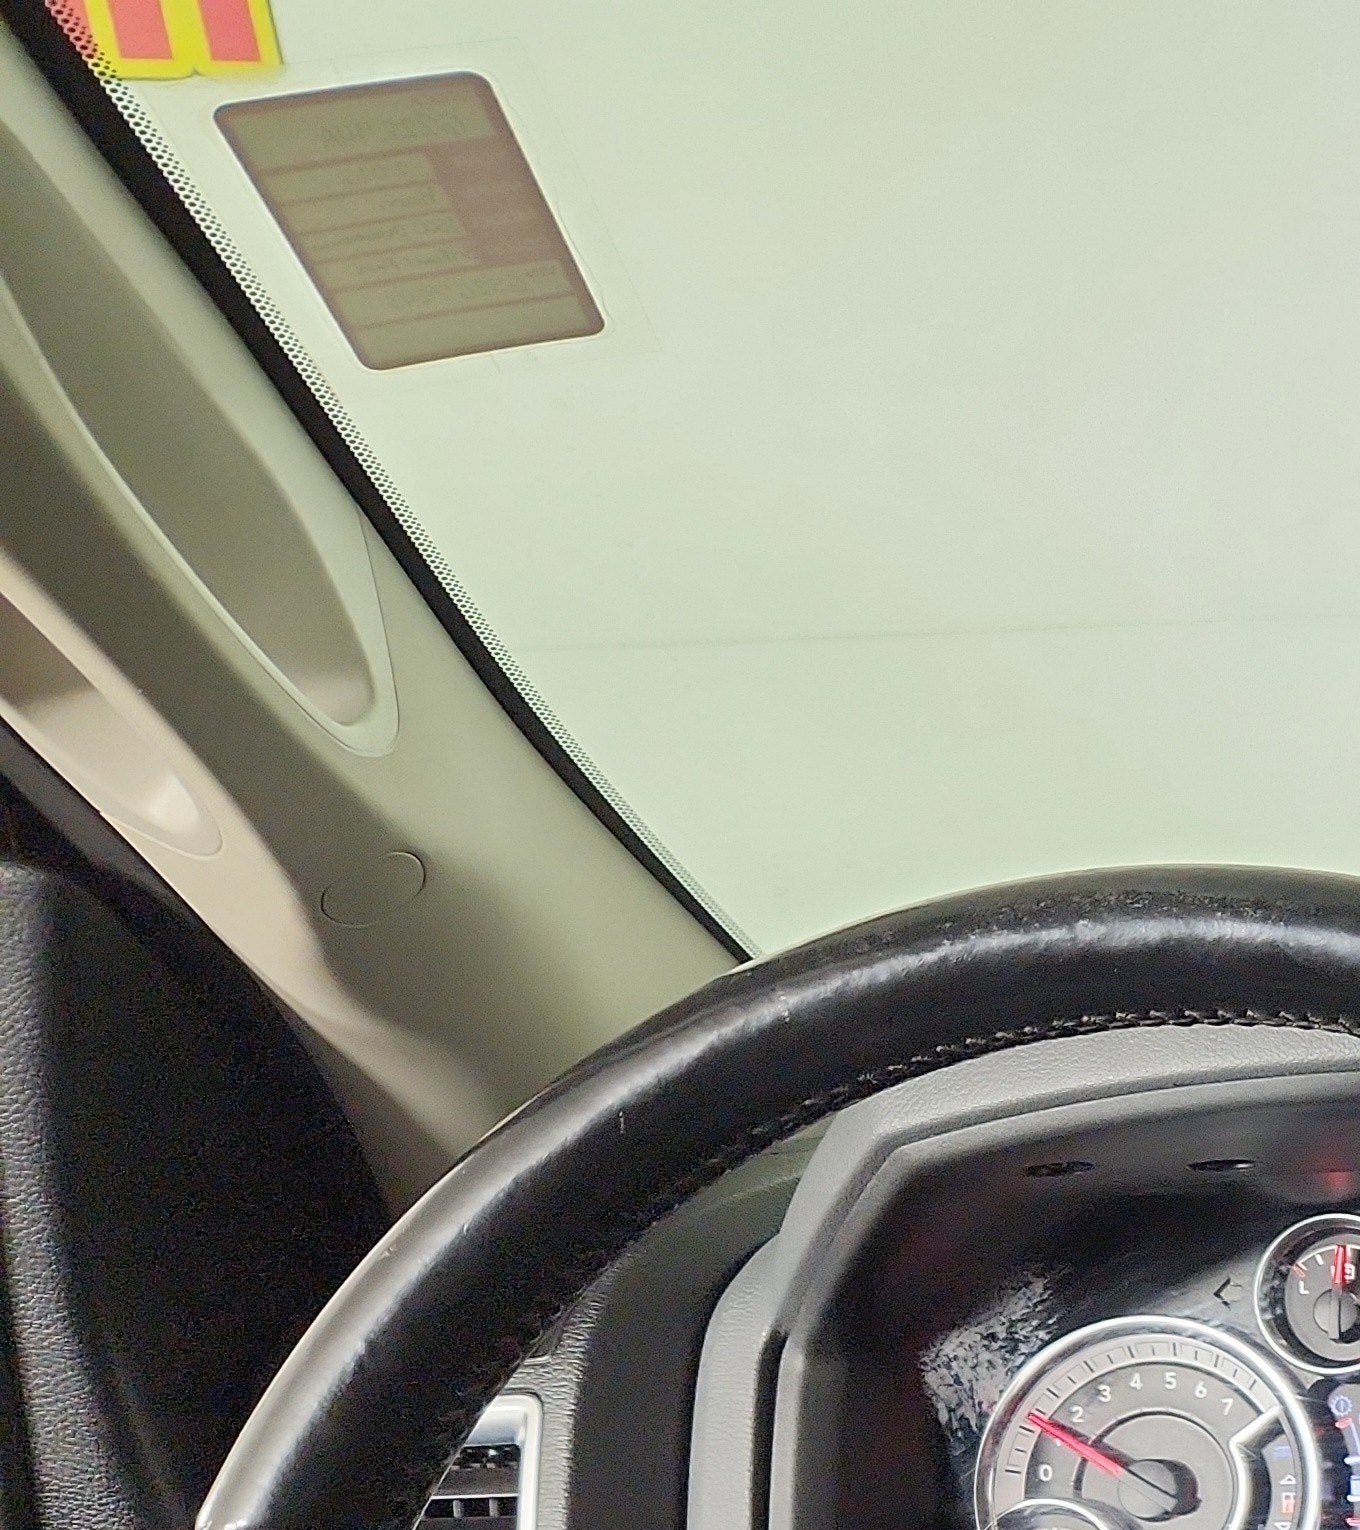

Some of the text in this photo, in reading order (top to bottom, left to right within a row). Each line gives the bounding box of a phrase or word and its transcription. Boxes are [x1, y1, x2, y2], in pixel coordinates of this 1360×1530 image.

[1299, 1282, 1309, 1294] L
[1130, 1373, 1143, 1390] 4
[1165, 1372, 1176, 1388] 5
[1099, 1385, 1111, 1402] 3
[1194, 1382, 1207, 1398] 6
[1222, 1398, 1234, 1415] 7
[1072, 1407, 1084, 1423] 2
[1039, 1464, 1053, 1482] 0
